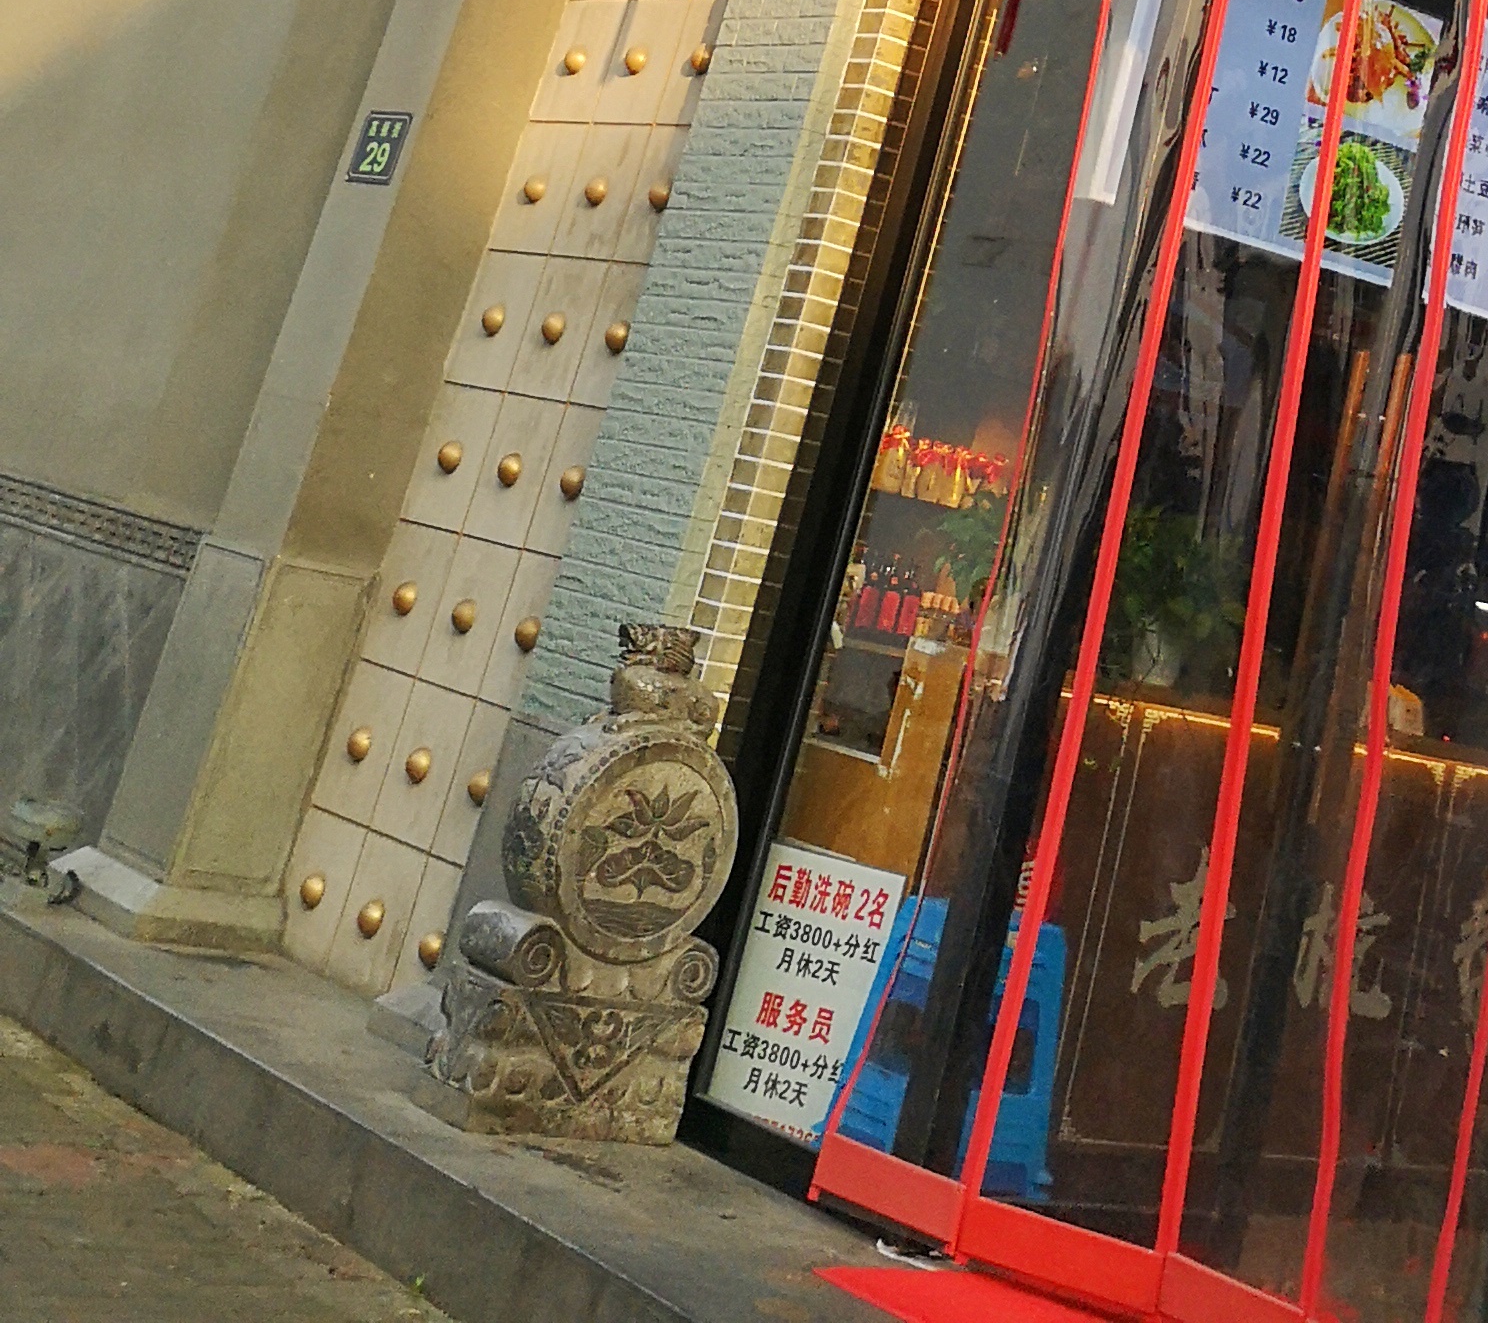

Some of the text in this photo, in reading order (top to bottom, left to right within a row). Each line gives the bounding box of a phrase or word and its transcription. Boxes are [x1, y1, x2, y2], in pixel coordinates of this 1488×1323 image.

[1266, 18, 1297, 43] ¥18
[1258, 60, 1288, 85] ¥12
[1249, 101, 1280, 126] ¥29
[359, 141, 391, 173] 29
[1239, 142, 1271, 168] ¥22
[1231, 186, 1262, 210] ¥22
[767, 864, 889, 930] 后勤洗碗2名
[754, 910, 880, 964] 工资3800+分红
[776, 947, 840, 986] 月休2天
[756, 991, 835, 1045] 服务员
[722, 1028, 845, 1084] 工资3800+分红
[743, 1067, 809, 1108] 月休2天
